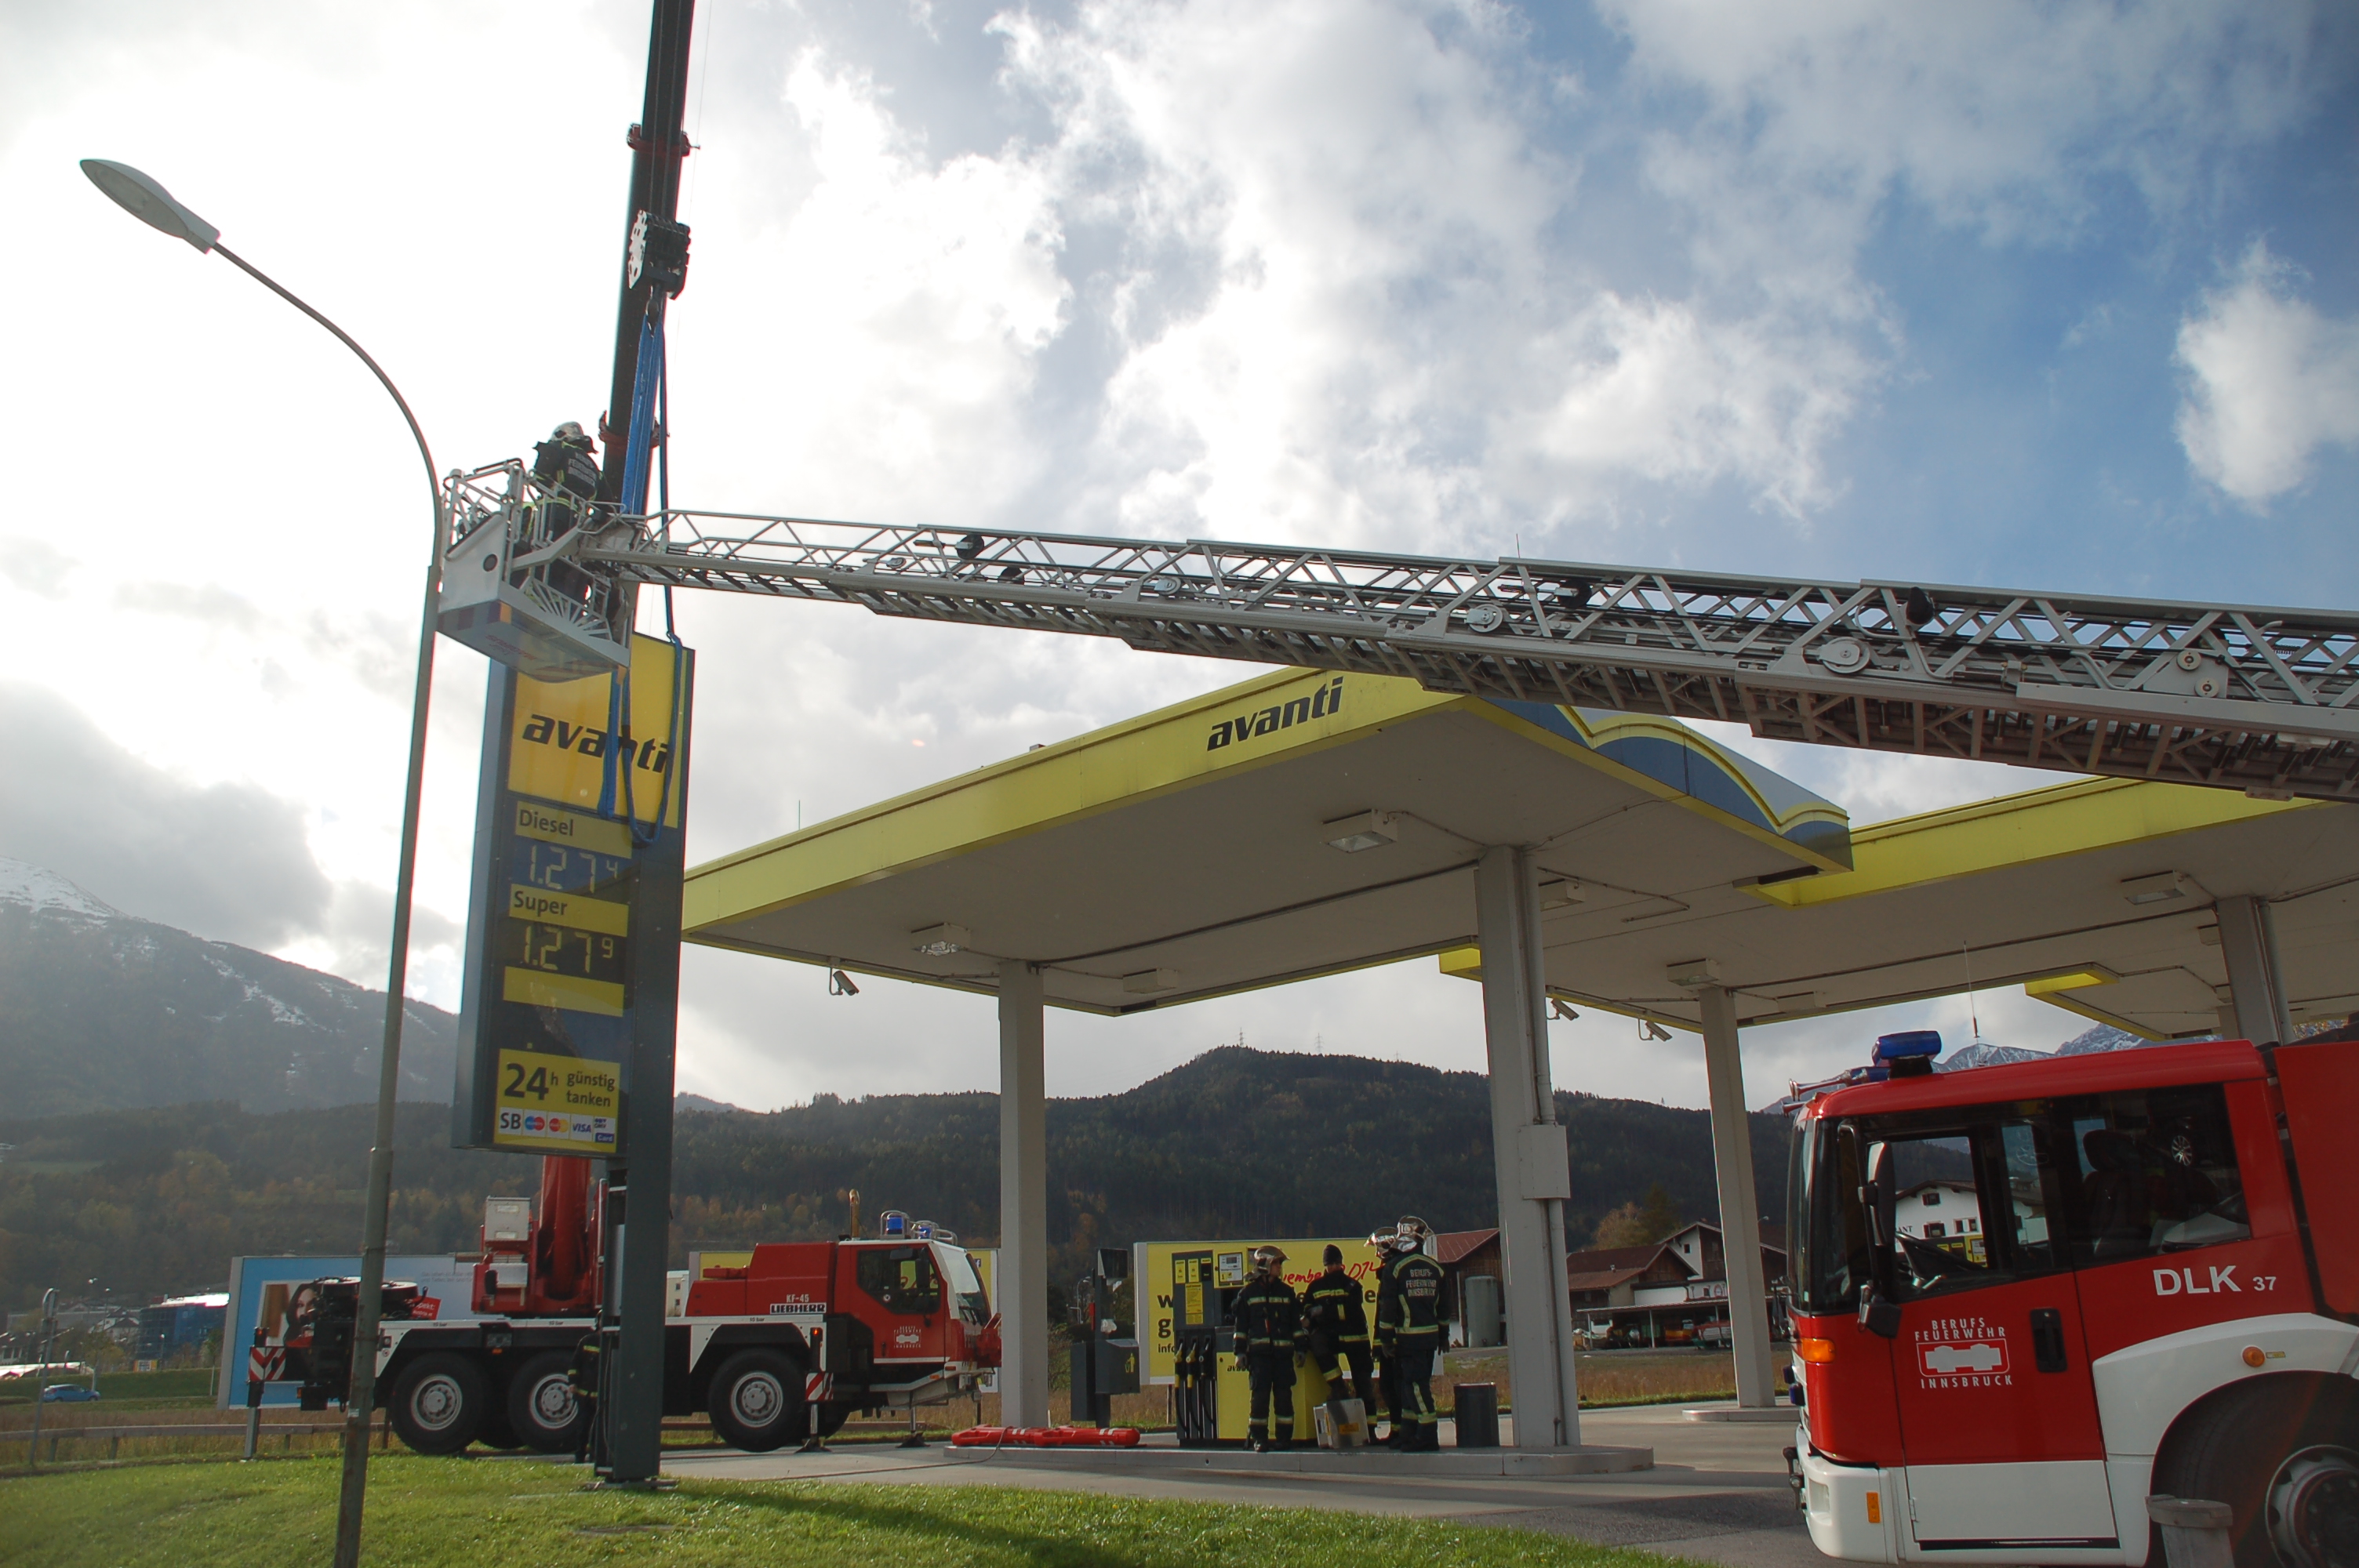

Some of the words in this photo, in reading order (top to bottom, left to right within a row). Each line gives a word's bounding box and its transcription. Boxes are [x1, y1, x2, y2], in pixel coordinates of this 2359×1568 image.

[1207, 676, 1344, 752] avanti
[519, 809, 574, 837] Diesel
[514, 890, 568, 917] Super
[504, 1062, 549, 1101] 24
[551, 1072, 559, 1086] h
[567, 1070, 616, 1092] günstig
[566, 1090, 611, 1107] tanken
[500, 1112, 522, 1130] SB
[572, 1123, 592, 1133] VISA
[2153, 1265, 2242, 1296] DLK
[2252, 1276, 2277, 1291] 37
[786, 1294, 809, 1303] KF-45
[771, 1304, 825, 1313] LIEBHERR
[1932, 1317, 1985, 1330] BERUFS
[1914, 1327, 2006, 1341] FEUERWEHR
[1920, 1375, 2013, 1389] INNSBRUCK
